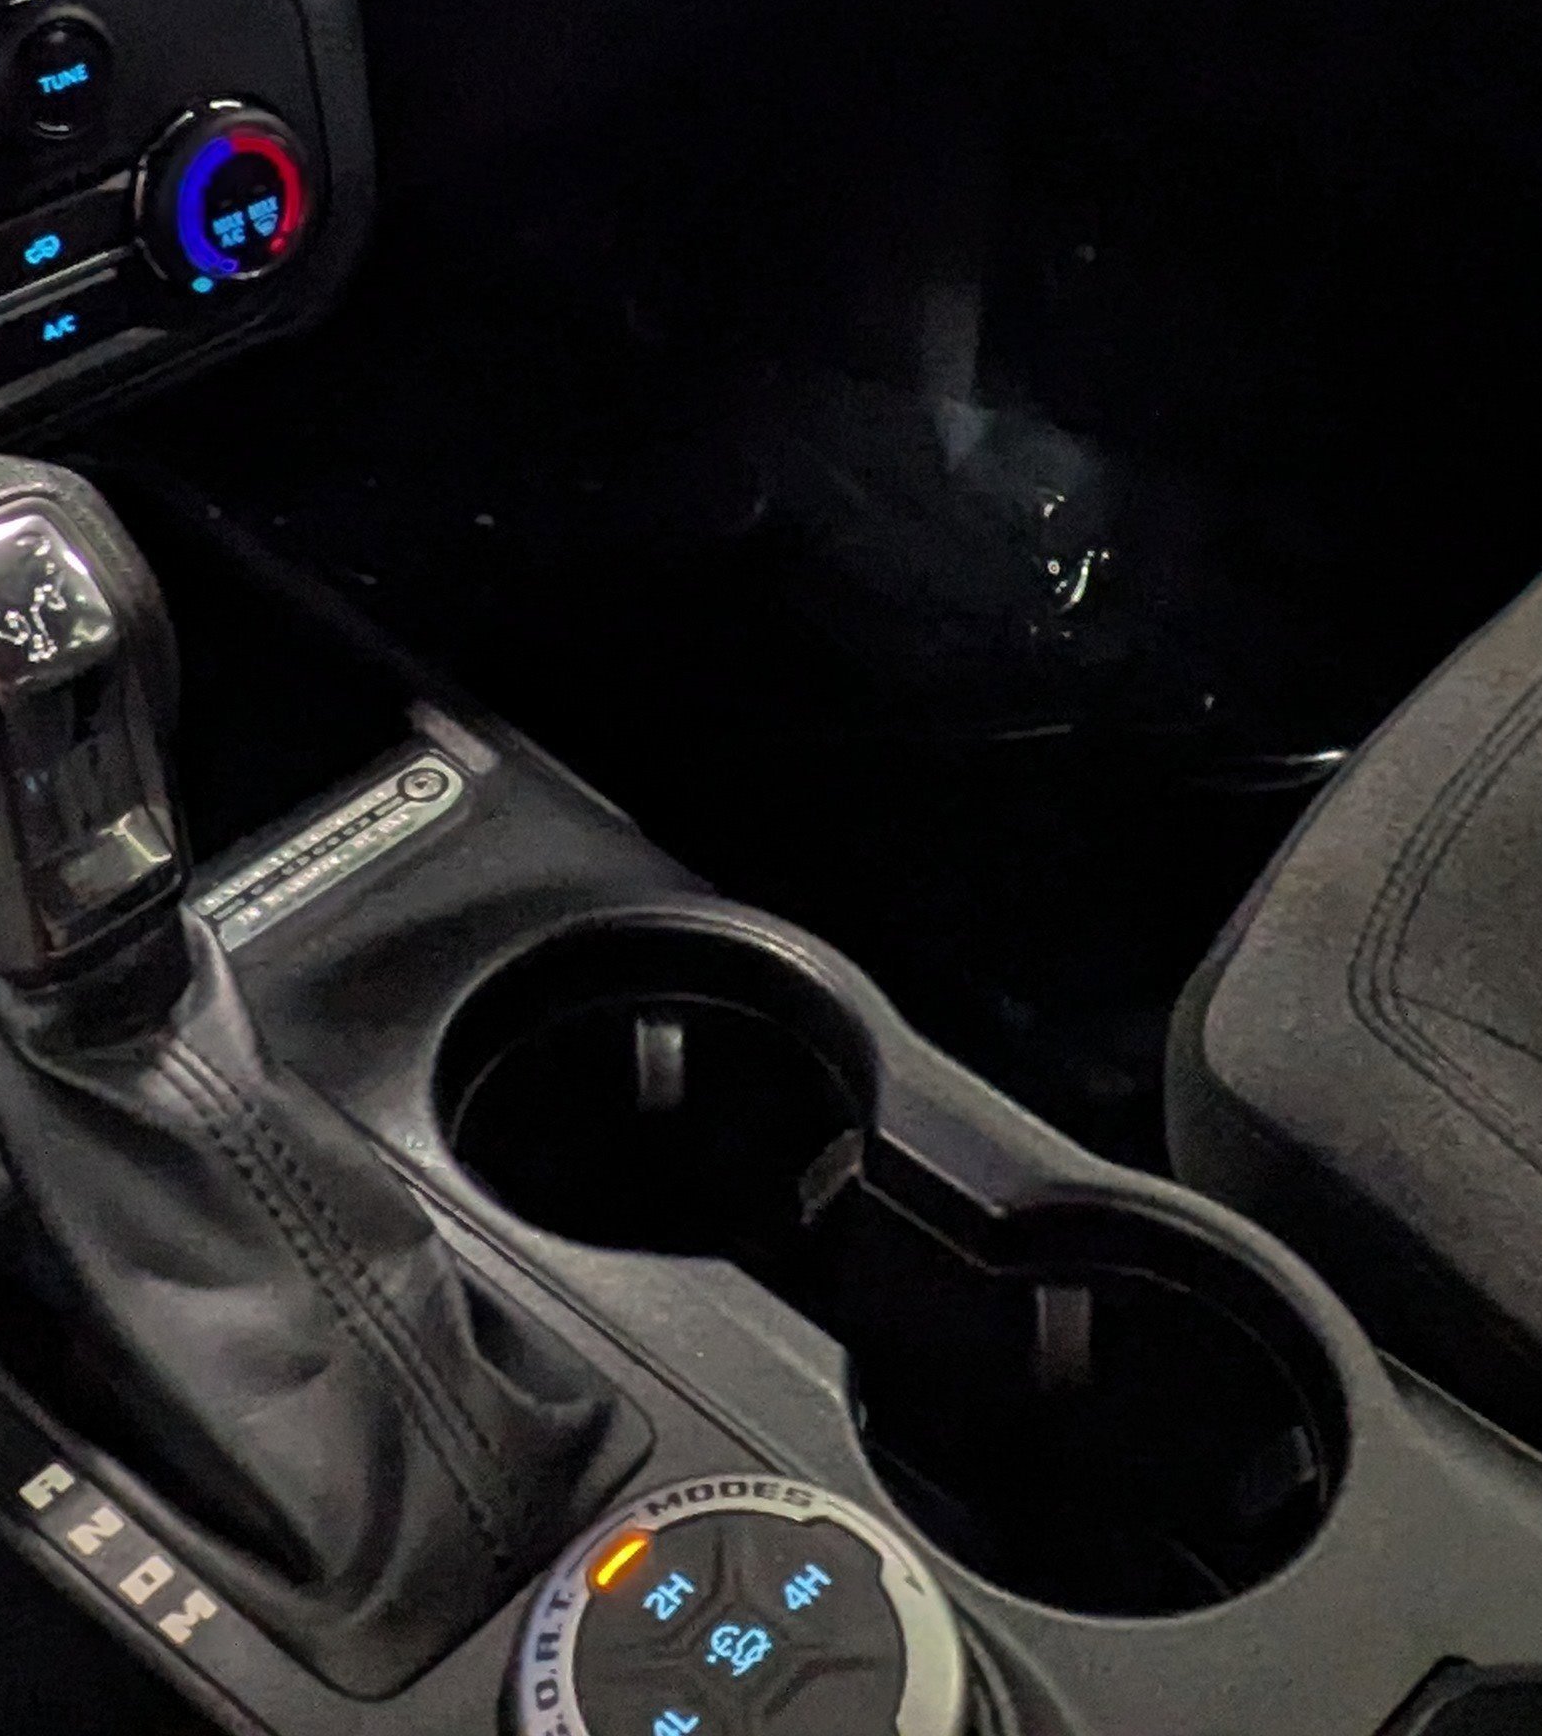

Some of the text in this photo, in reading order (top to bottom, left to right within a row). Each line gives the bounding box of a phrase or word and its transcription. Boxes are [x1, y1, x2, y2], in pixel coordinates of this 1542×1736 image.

[38, 63, 89, 93] TUNE
[42, 314, 77, 341] A/C
[647, 1481, 813, 1516] MODES
[642, 1571, 696, 1622] 2H
[782, 1563, 833, 1611] 4H
